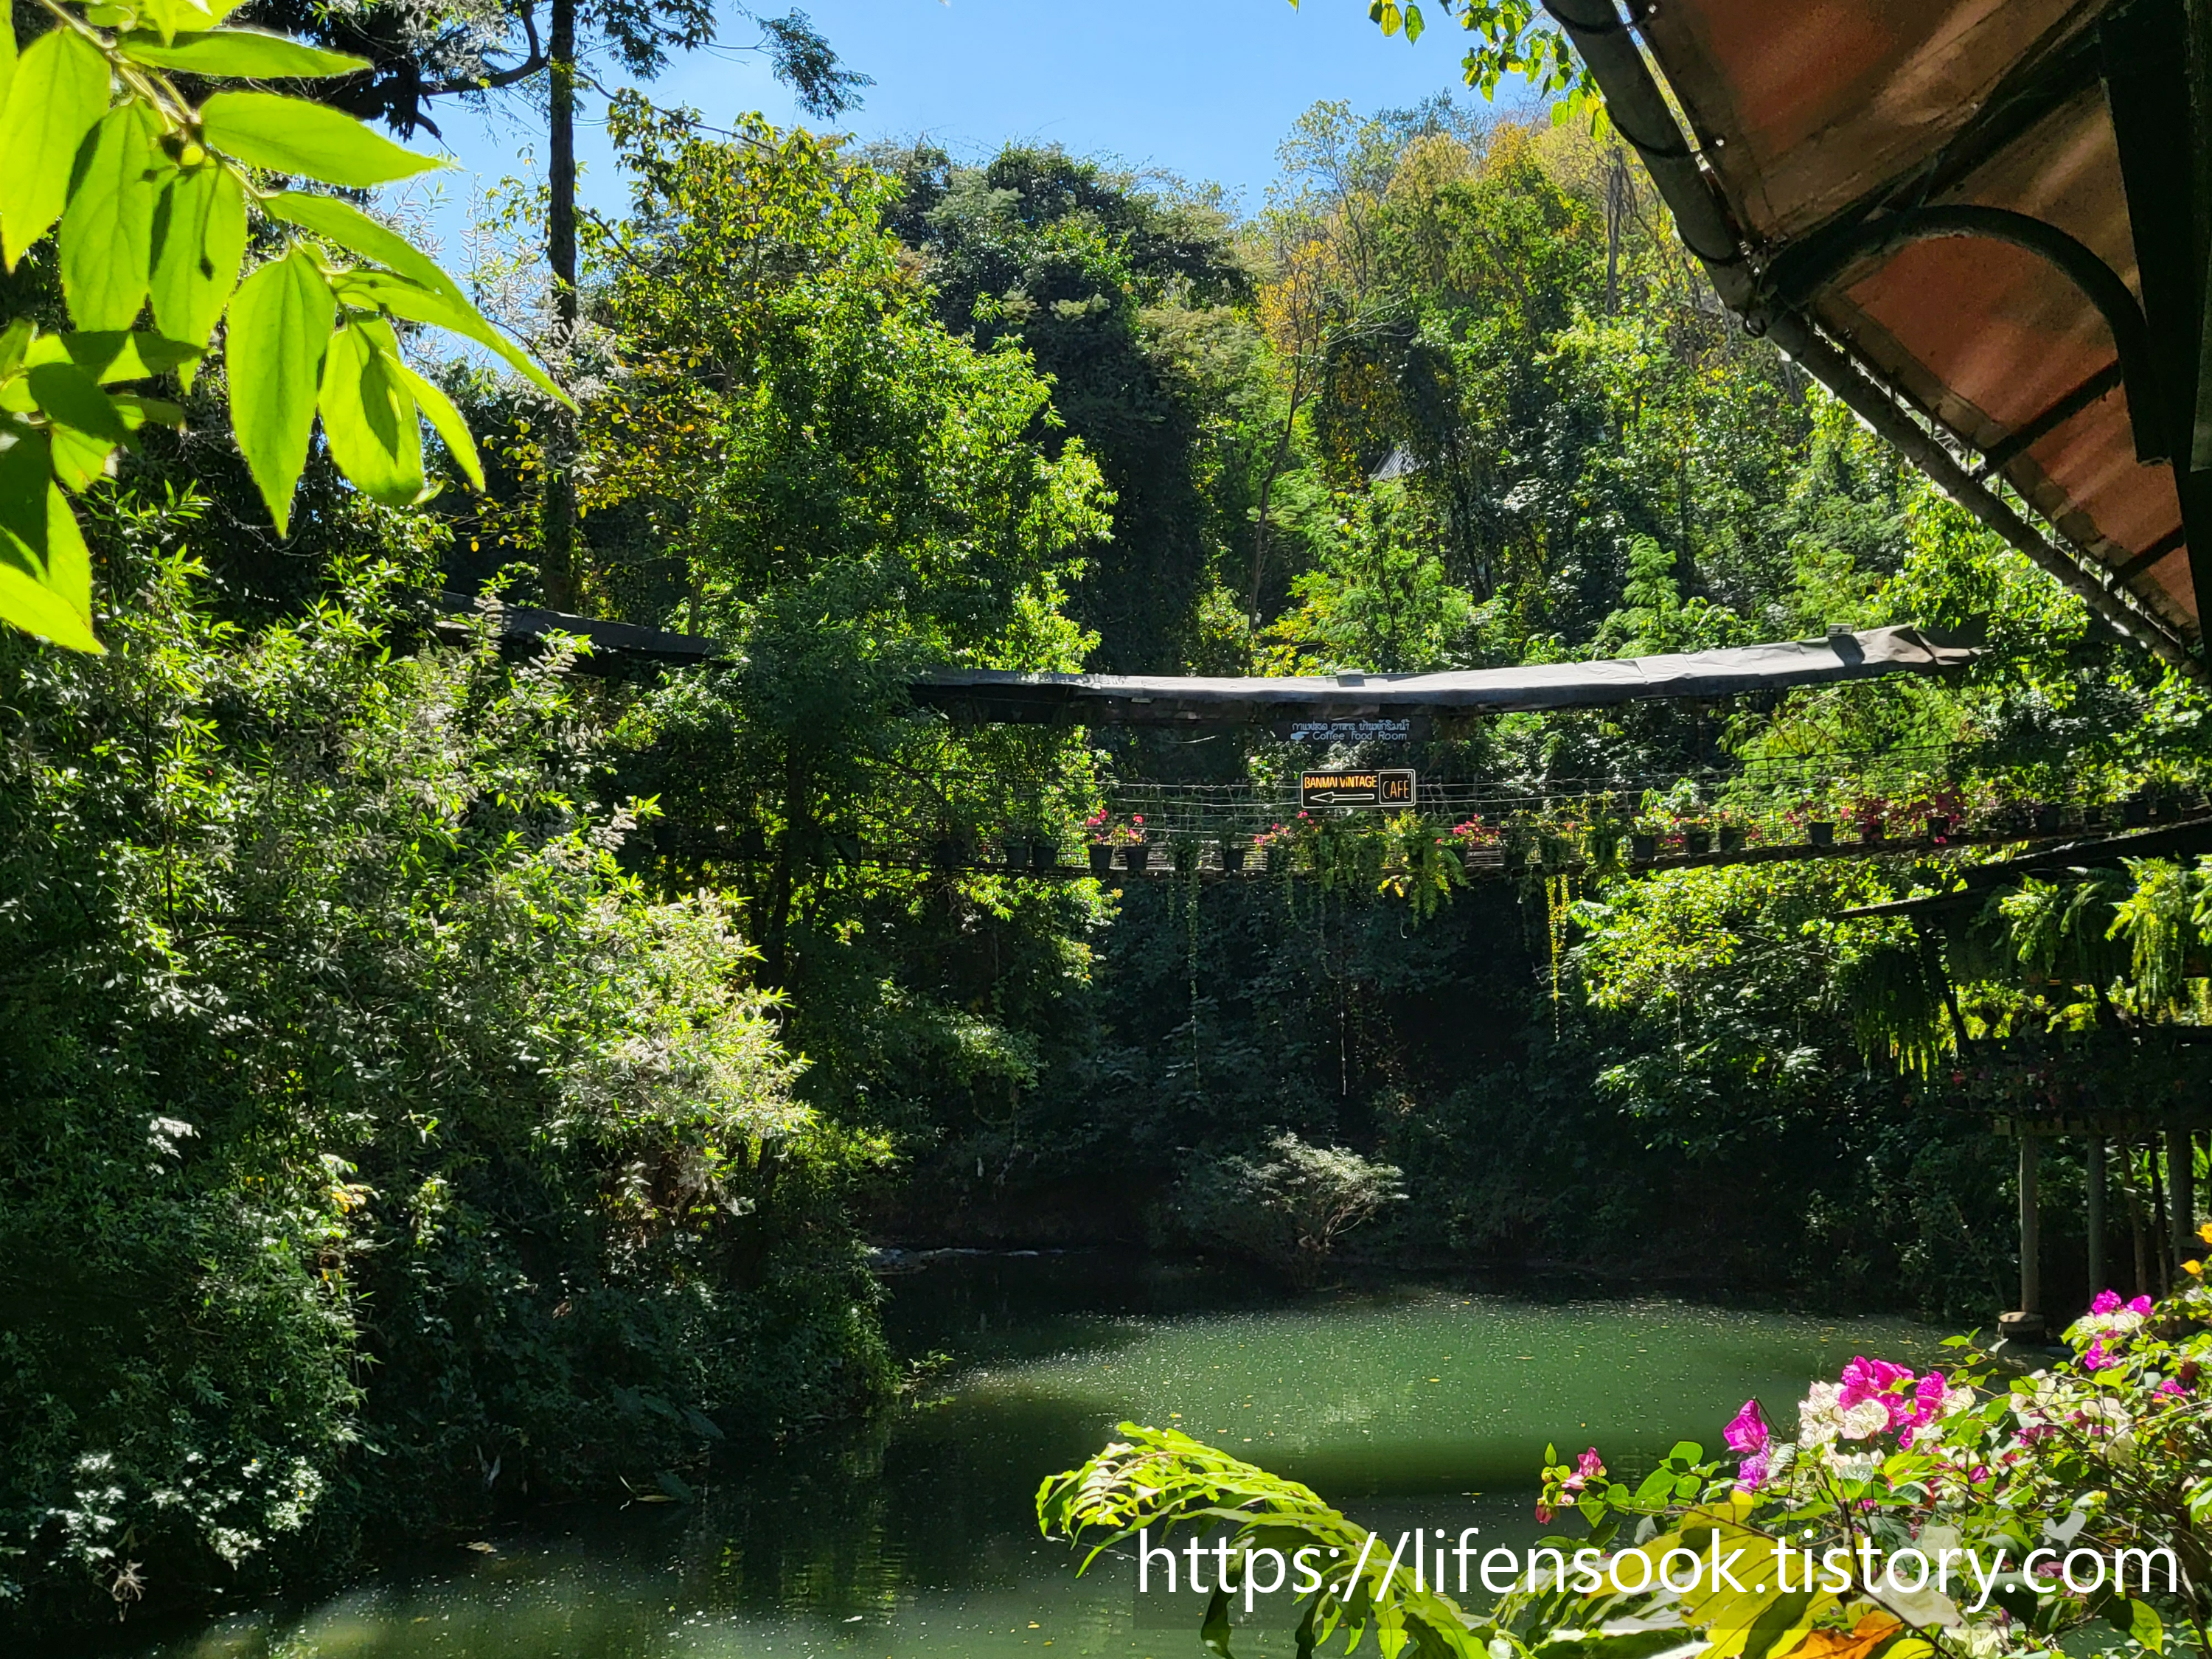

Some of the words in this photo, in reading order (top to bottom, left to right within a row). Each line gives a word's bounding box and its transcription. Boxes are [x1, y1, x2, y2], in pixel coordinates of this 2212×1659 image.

[1312, 731, 1345, 740] Coffee
[1351, 731, 1372, 740] Food
[1378, 731, 1407, 740] Room
[1304, 776, 1338, 789] BANMAI
